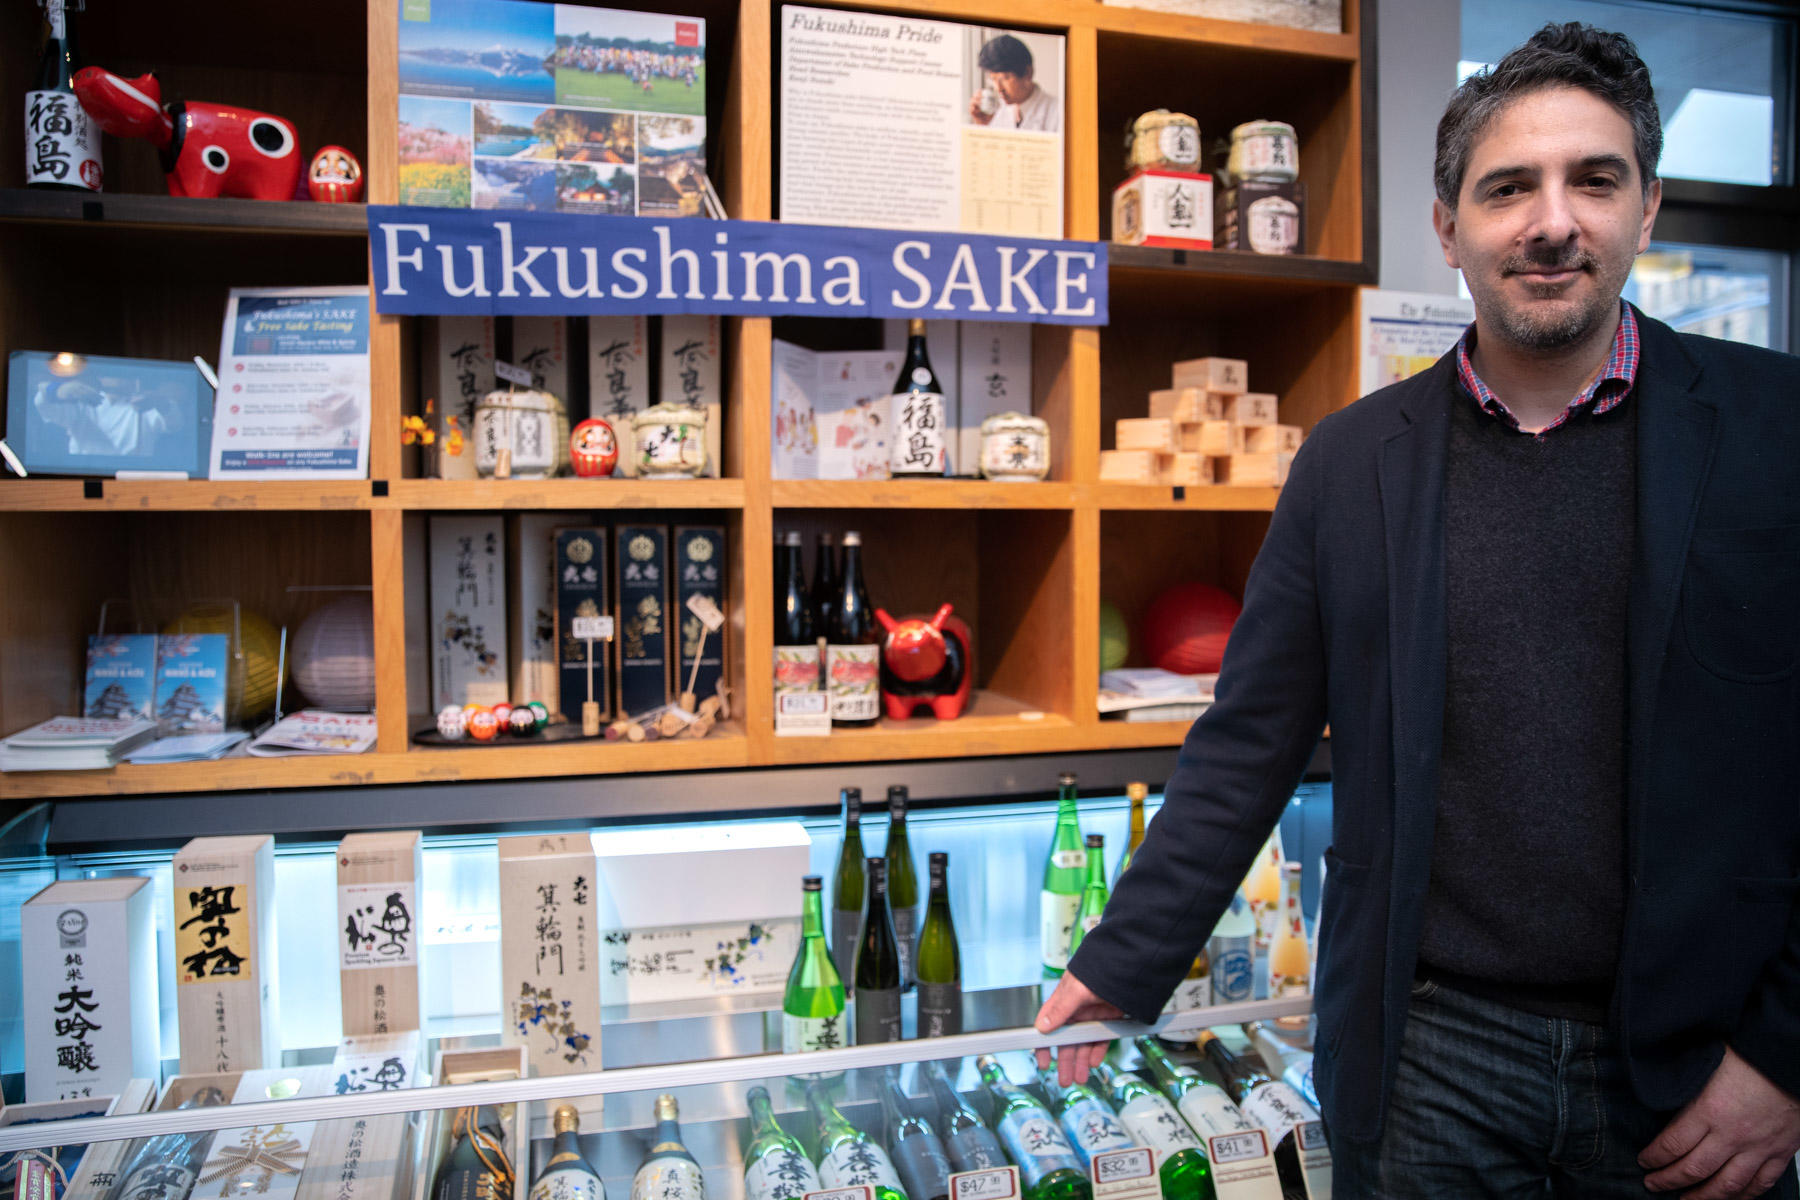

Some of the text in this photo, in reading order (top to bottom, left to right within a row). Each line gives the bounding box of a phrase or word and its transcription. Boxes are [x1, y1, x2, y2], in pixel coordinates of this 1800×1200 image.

[790, 13, 943, 44] Fukushima Pride
[30, 94, 72, 180] 福島
[378, 222, 1098, 317] Fukushima SAKE
[903, 396, 935, 468] 福島
[1217, 1139, 1239, 1154] $41
[1101, 1159, 1125, 1173] $32
[960, 1177, 986, 1193] $47
